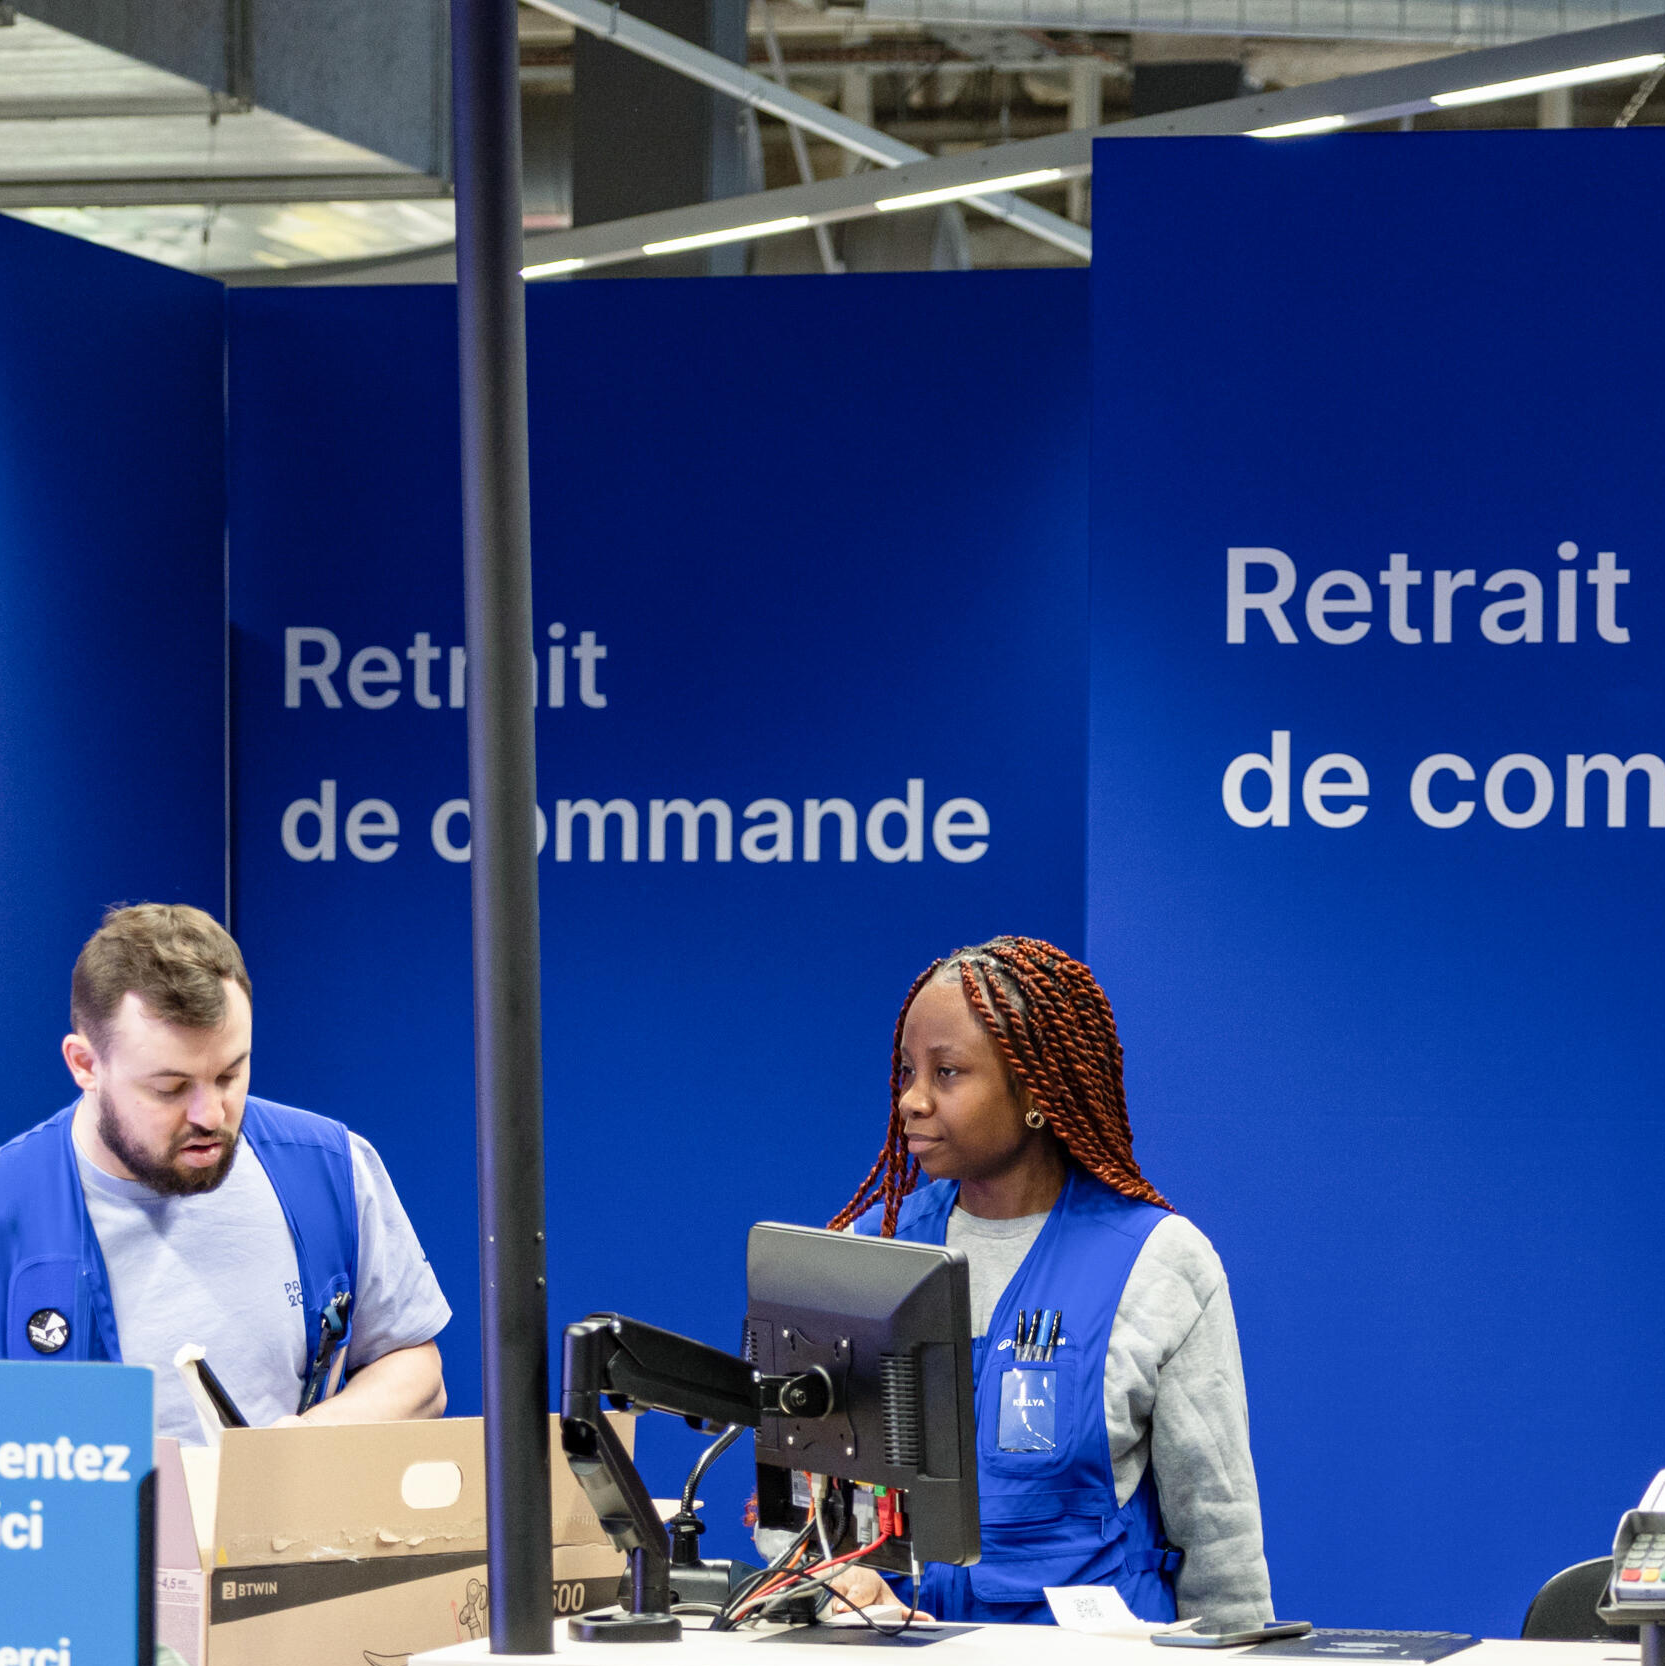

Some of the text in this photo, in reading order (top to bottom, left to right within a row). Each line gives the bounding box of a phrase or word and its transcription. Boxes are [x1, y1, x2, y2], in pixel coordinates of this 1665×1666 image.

[1226, 541, 1630, 645] Retrait
[285, 622, 607, 709] Retrit
[281, 779, 400, 863] de
[1222, 730, 1370, 829] de
[238, 1581, 278, 1597] BTWIN
